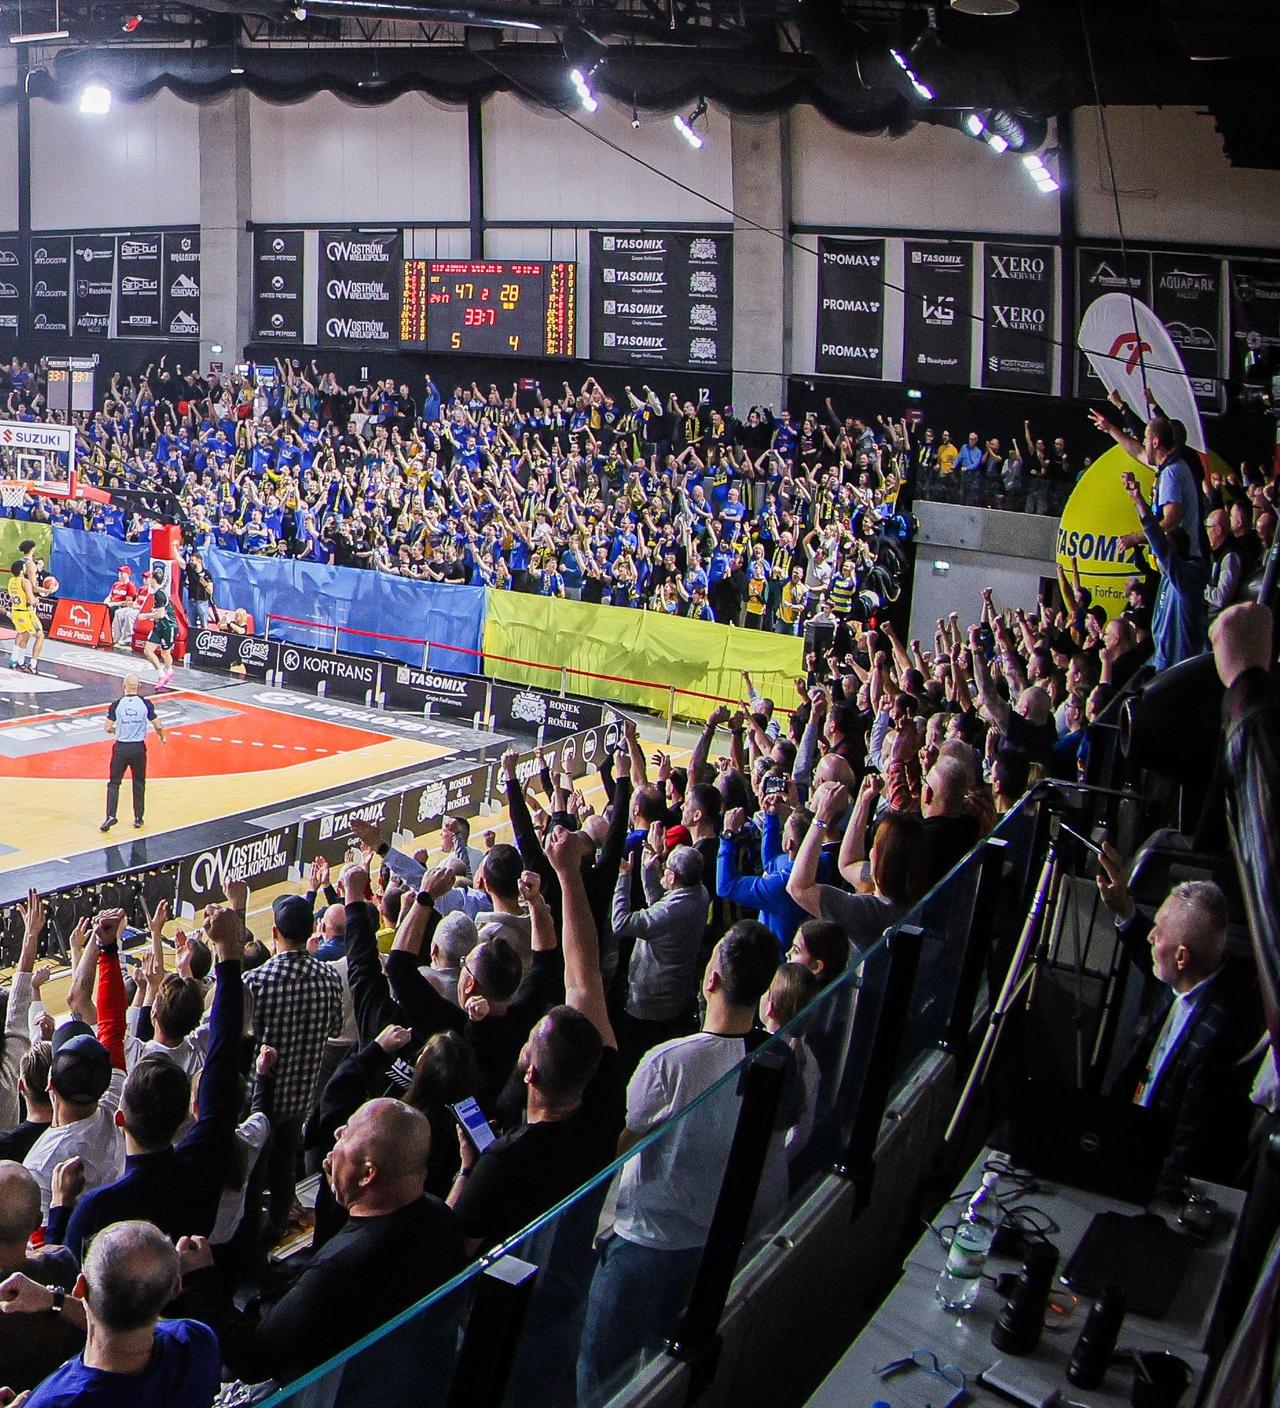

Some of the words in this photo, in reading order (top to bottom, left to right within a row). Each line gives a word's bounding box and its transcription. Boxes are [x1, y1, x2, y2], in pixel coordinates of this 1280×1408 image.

[351, 242, 384, 254] OSTRÓW
[616, 239, 664, 250] TASOMIX
[349, 253, 389, 262] WIELKOPOLSKI
[823, 252, 871, 267] PROMAX
[921, 253, 962, 264] TASOMIX
[991, 255, 1045, 279] XERO
[616, 271, 664, 282] TASOMIX
[1008, 272, 1043, 281] SERVICE
[1159, 276, 1215, 292] AQUAPARK
[351, 279, 385, 292] OSTRÓW
[455, 283, 474, 299] 47
[499, 284, 520, 302] 28
[349, 291, 390, 301] WIELKOPOLSKI
[481, 288, 490, 301] 2
[616, 303, 665, 314] TASOMIX
[822, 298, 871, 313] PROMAX
[464, 308, 496, 326] 33:7
[991, 305, 1046, 328] XERO
[351, 318, 384, 331] OSTRÓW
[1009, 322, 1044, 332] SERVICE
[349, 330, 389, 339] WIELKOPOLSKI
[451, 332, 461, 349] 5
[616, 335, 665, 347] TASOMIX
[508, 335, 520, 351] 4
[821, 343, 869, 359] PROMAX
[698, 388, 710, 402] 12
[15, 431, 61, 446] SUZUKI
[37, 602, 55, 613] CITY
[56, 627, 72, 638] Bank
[73, 630, 94, 642] Pekao
[196, 631, 228, 655] Grześ
[238, 638, 269, 662] Grześ
[302, 655, 374, 683] KORTRANS
[408, 671, 468, 693] TASOMIX
[549, 700, 581, 714] ROSIEK
[559, 711, 568, 720] &
[547, 716, 579, 731] ROSIEK
[448, 775, 473, 790] ROSIEK
[456, 789, 463, 798] &
[446, 794, 471, 811] ROSIEK
[231, 832, 282, 867] OSTRÓW
